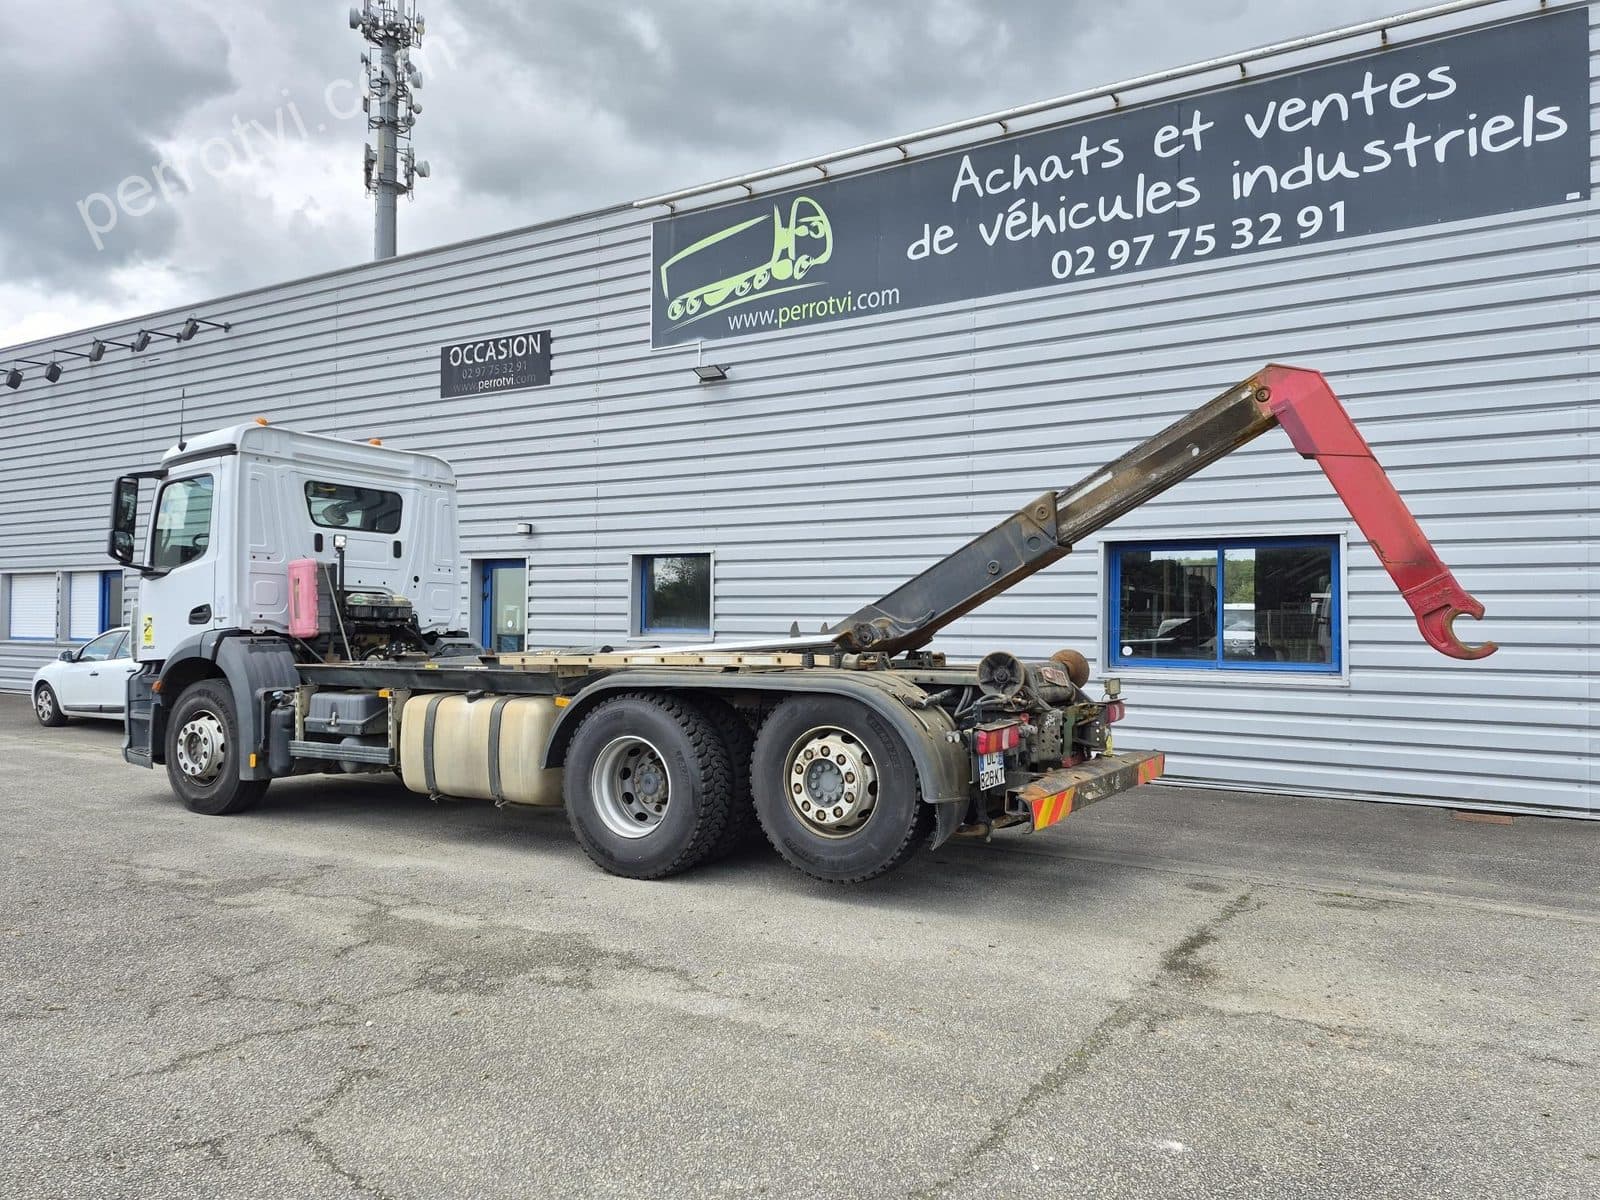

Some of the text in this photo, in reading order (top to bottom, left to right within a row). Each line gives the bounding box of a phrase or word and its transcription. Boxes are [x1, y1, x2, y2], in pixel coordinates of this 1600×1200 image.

[952, 65, 1457, 203] Achats et ventes
[906, 94, 1568, 261] de véhicules industriels
[1051, 201, 1345, 280] 02 97 75 32 91
[727, 287, 900, 331] www.perrotvi.com
[449, 333, 541, 366] OCCASION
[462, 360, 527, 380] 02 97 75 32 91
[453, 373, 536, 392] www.perrotvi.com
